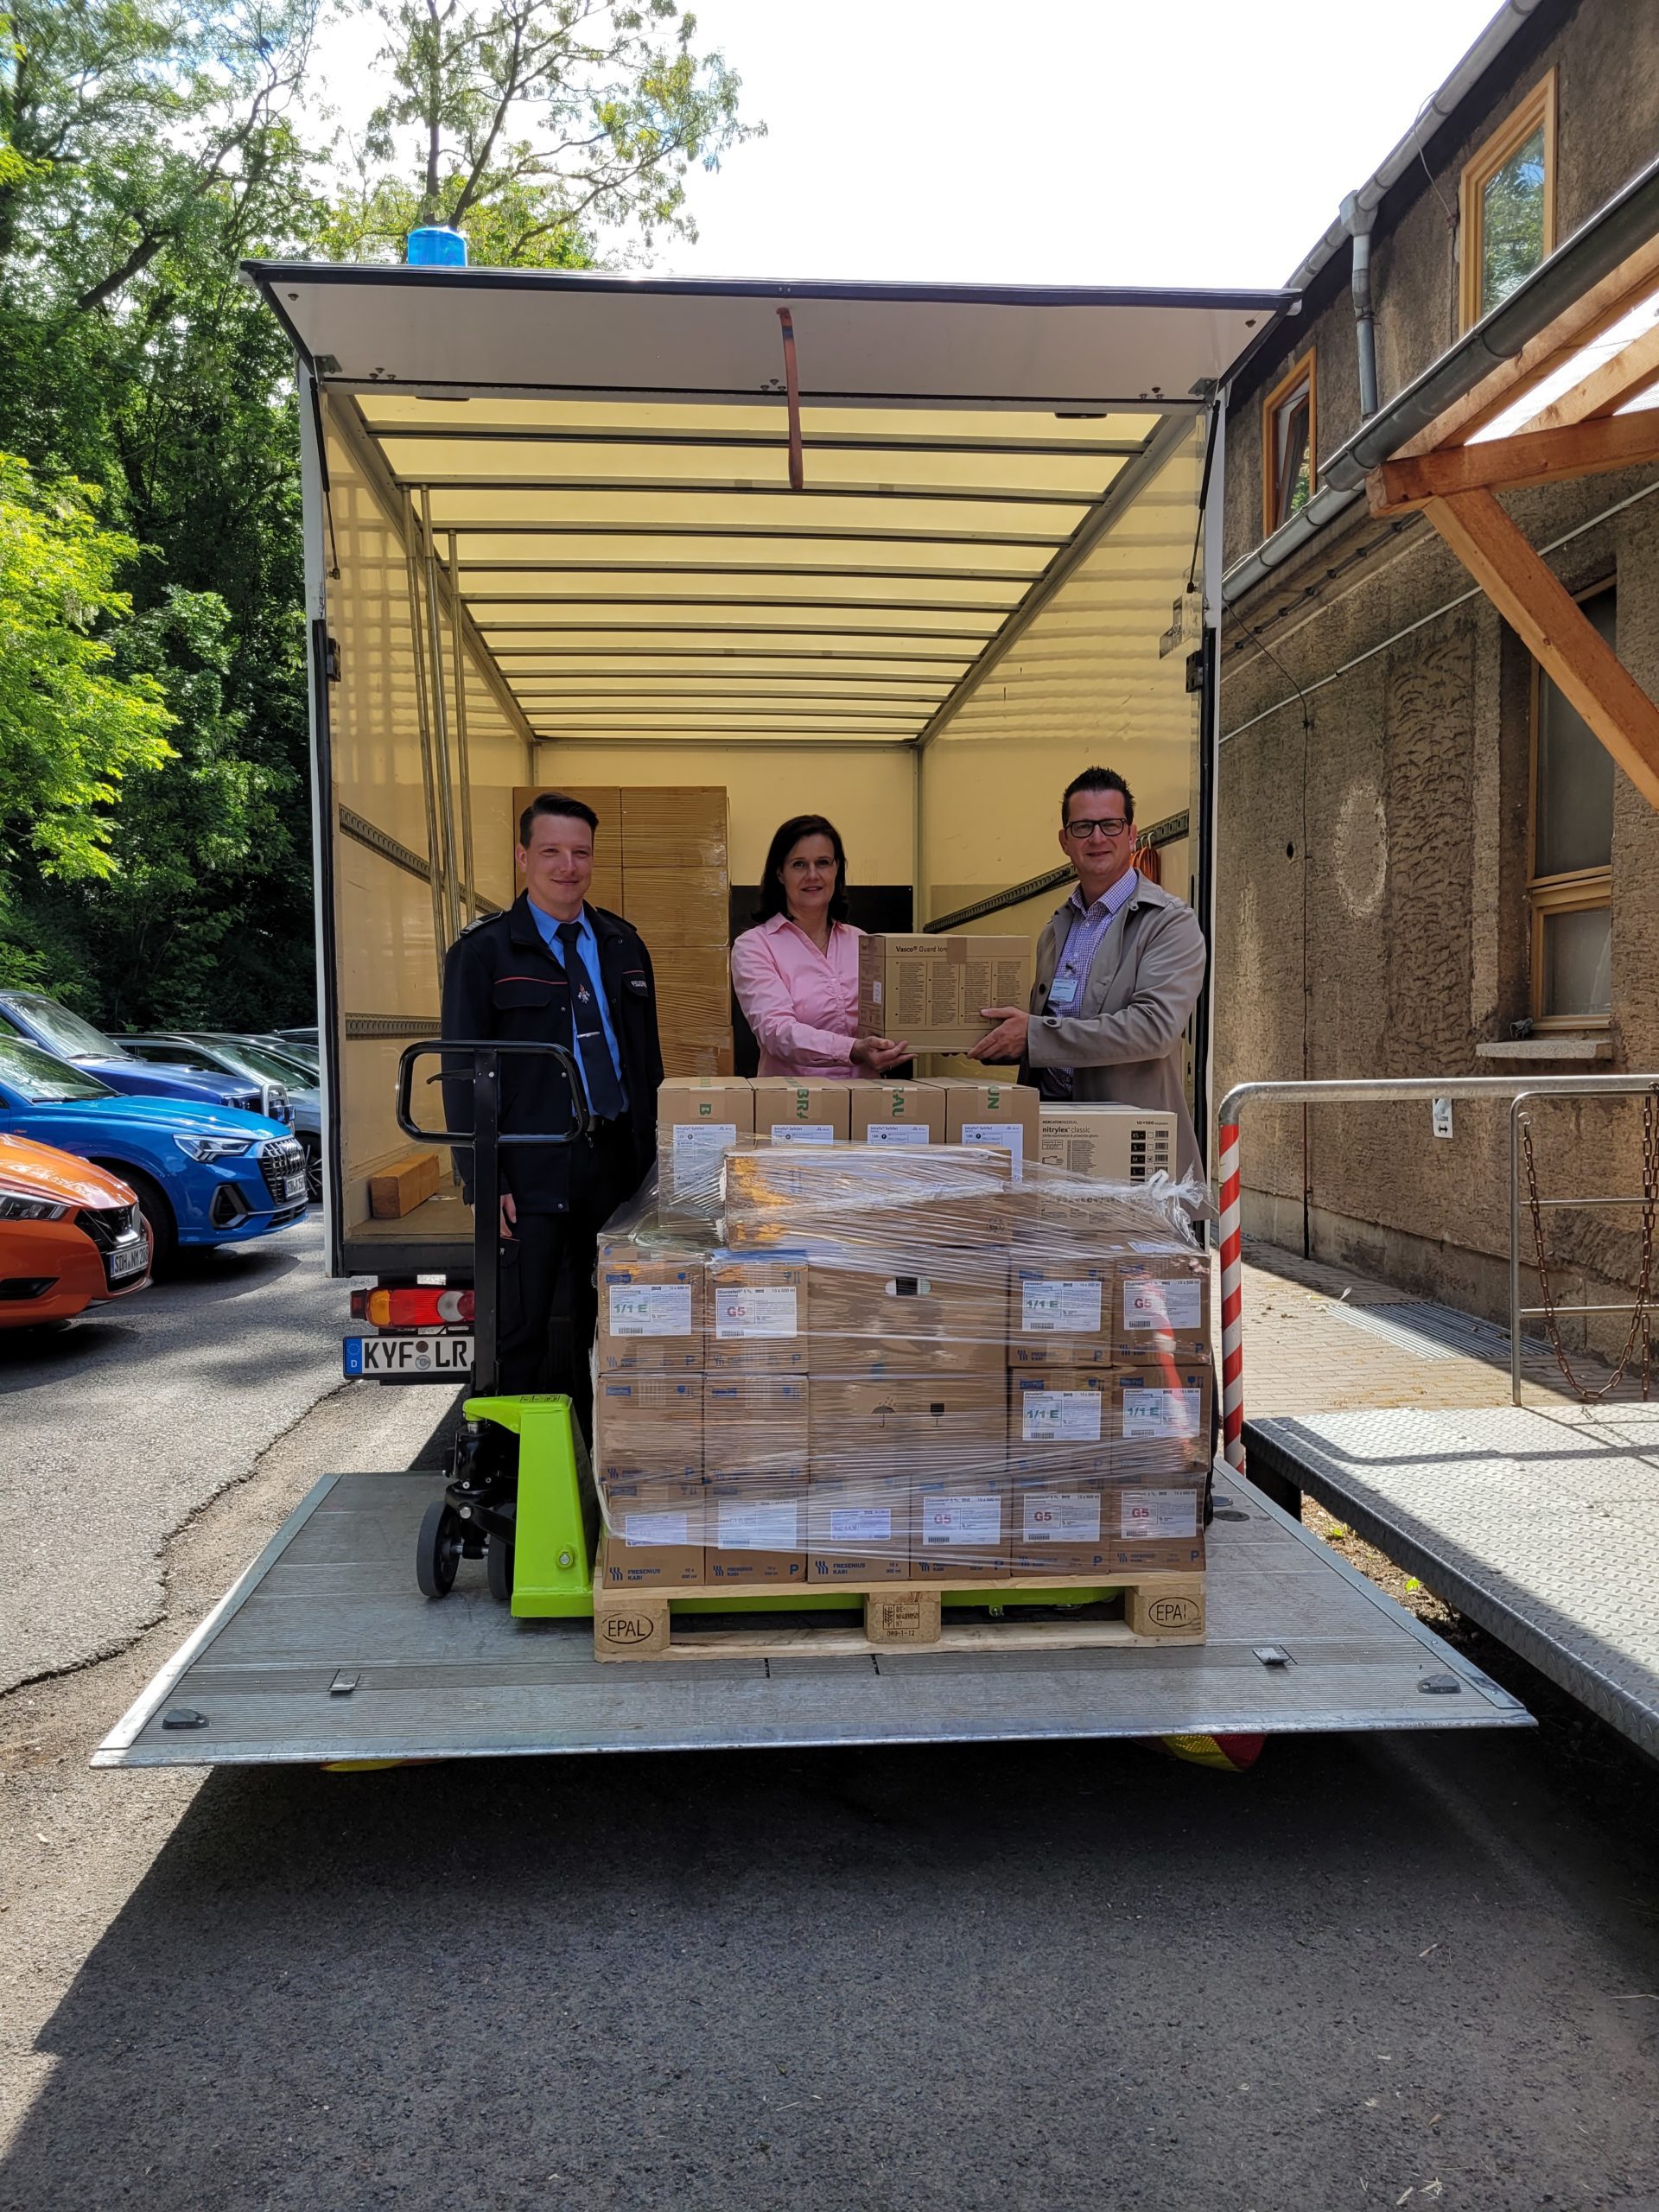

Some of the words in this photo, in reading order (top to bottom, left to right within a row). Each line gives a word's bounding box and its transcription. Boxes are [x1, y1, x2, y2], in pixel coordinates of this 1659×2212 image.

[614, 1304, 633, 1313] 1/1
[638, 1304, 648, 1313] E
[1027, 1300, 1046, 1309] 1/1
[1134, 1298, 1153, 1309] G5
[727, 1306, 746, 1317] G5
[364, 1342, 414, 1369] KYF
[435, 1340, 467, 1368] LR
[351, 1359, 358, 1368] D
[1027, 1410, 1046, 1419] 1/1
[1050, 1409, 1059, 1419] E
[1127, 1407, 1145, 1416] 1/1
[1149, 1407, 1160, 1416] E
[1033, 1511, 1052, 1522] G5
[1132, 1507, 1149, 1518] G5
[934, 1514, 951, 1524] G5
[1191, 1550, 1199, 1561] P
[790, 1563, 799, 1575] P
[607, 1619, 645, 1637] EPAL
